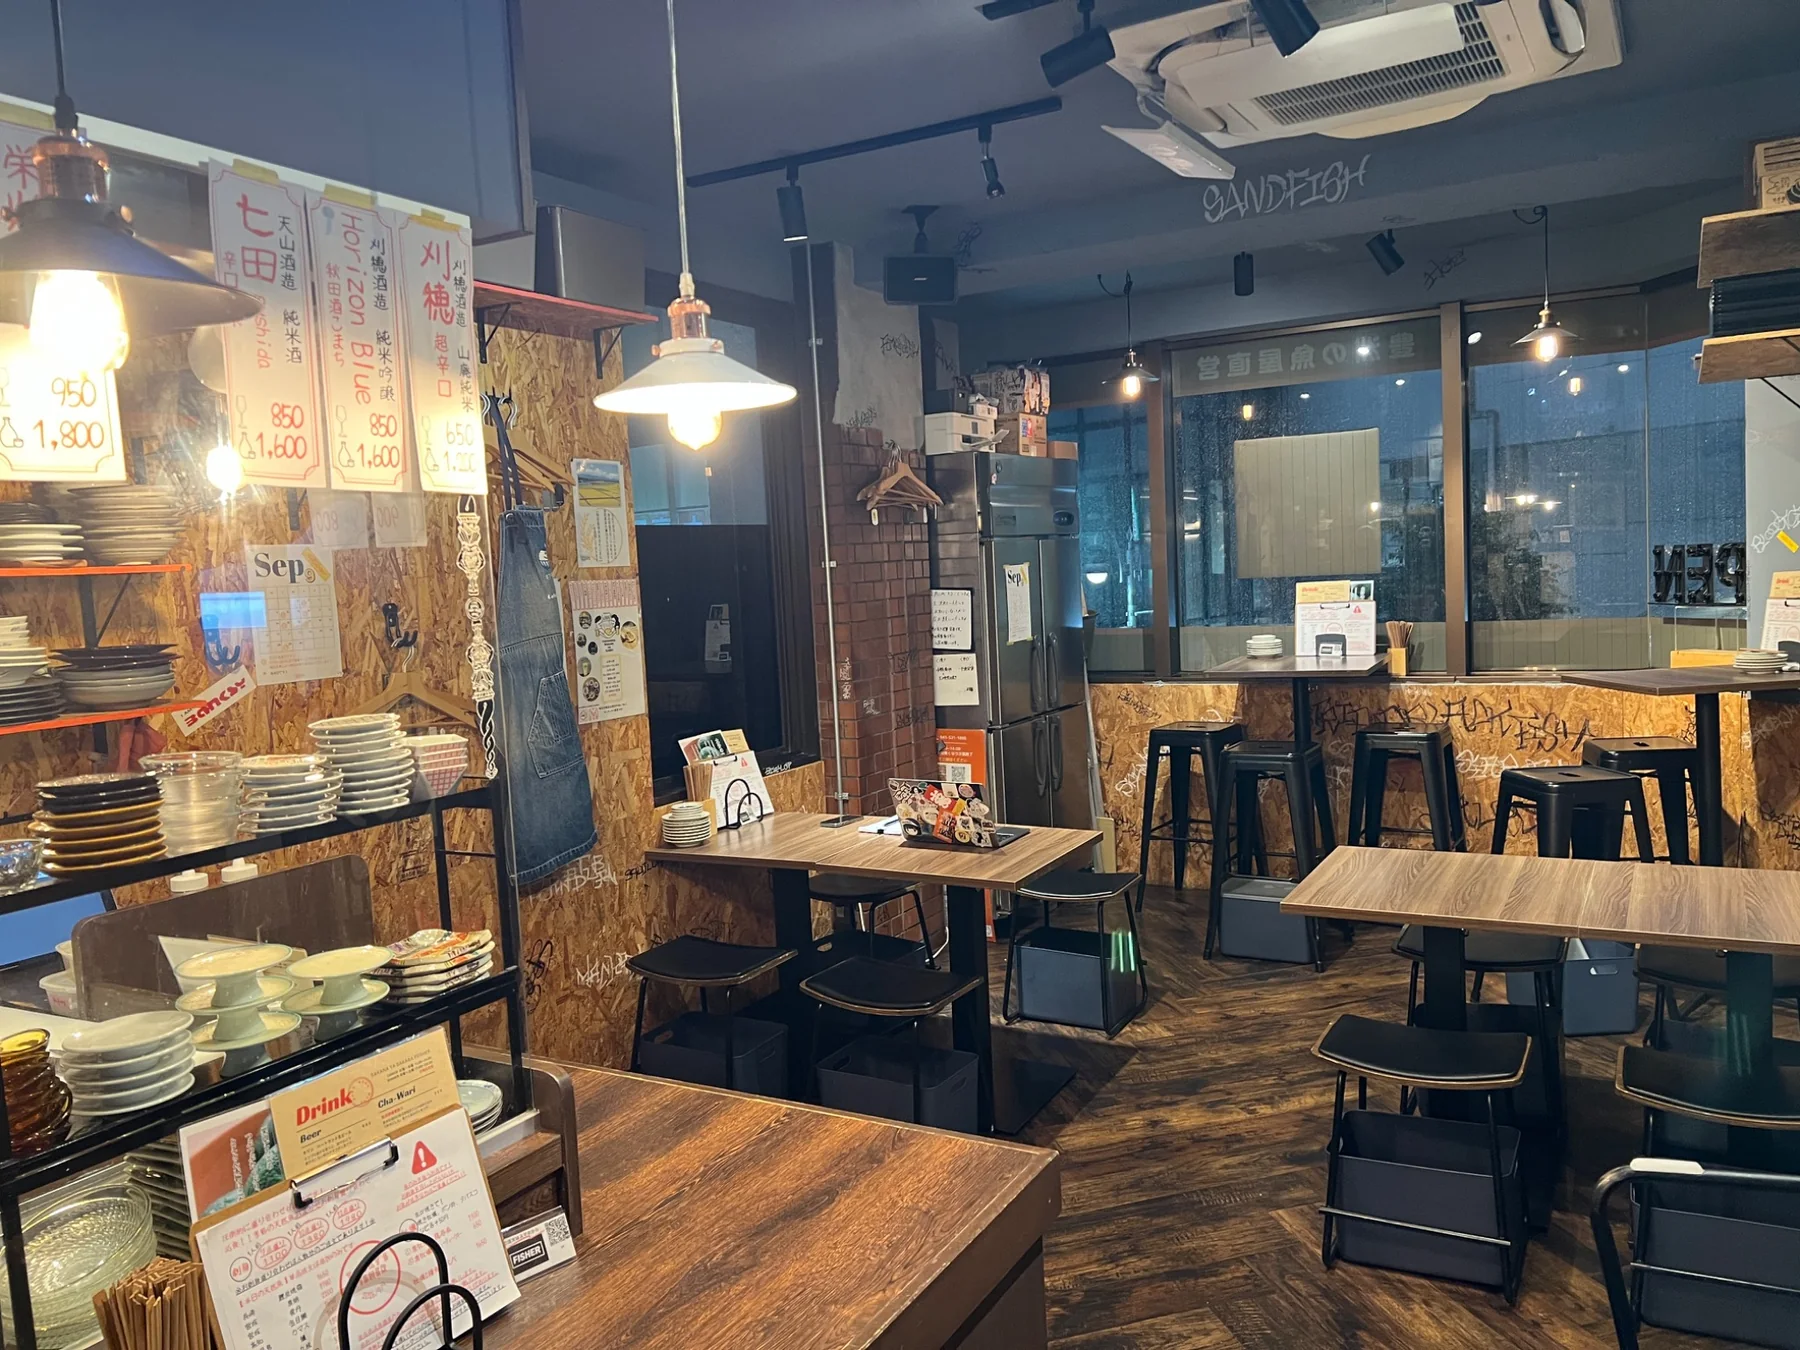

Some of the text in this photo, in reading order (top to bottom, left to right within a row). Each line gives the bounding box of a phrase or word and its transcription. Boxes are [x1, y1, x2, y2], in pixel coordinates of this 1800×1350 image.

[4, 144, 41, 232] 栄
[1202, 154, 1372, 224] SANDFISH
[236, 192, 277, 284] 七田
[278, 214, 303, 364] 天山酒造 純米酒
[420, 240, 454, 326] 刈穂
[341, 212, 375, 405] Horizon Blue
[434, 332, 452, 398] 超辛口
[51, 377, 97, 408] 950
[271, 402, 304, 429] 850
[369, 412, 397, 437] 850
[33, 419, 104, 451] 1,800
[256, 432, 307, 460] 1,600
[445, 420, 475, 446] 650
[356, 443, 400, 469] 1,600
[254, 552, 304, 584] Sep
[1007, 569, 1021, 587] Sep
[296, 1088, 353, 1127] Drink
[377, 1085, 417, 1109] Cha-Wari
[299, 1128, 322, 1144] Beer
[512, 1245, 542, 1265] FISHER
